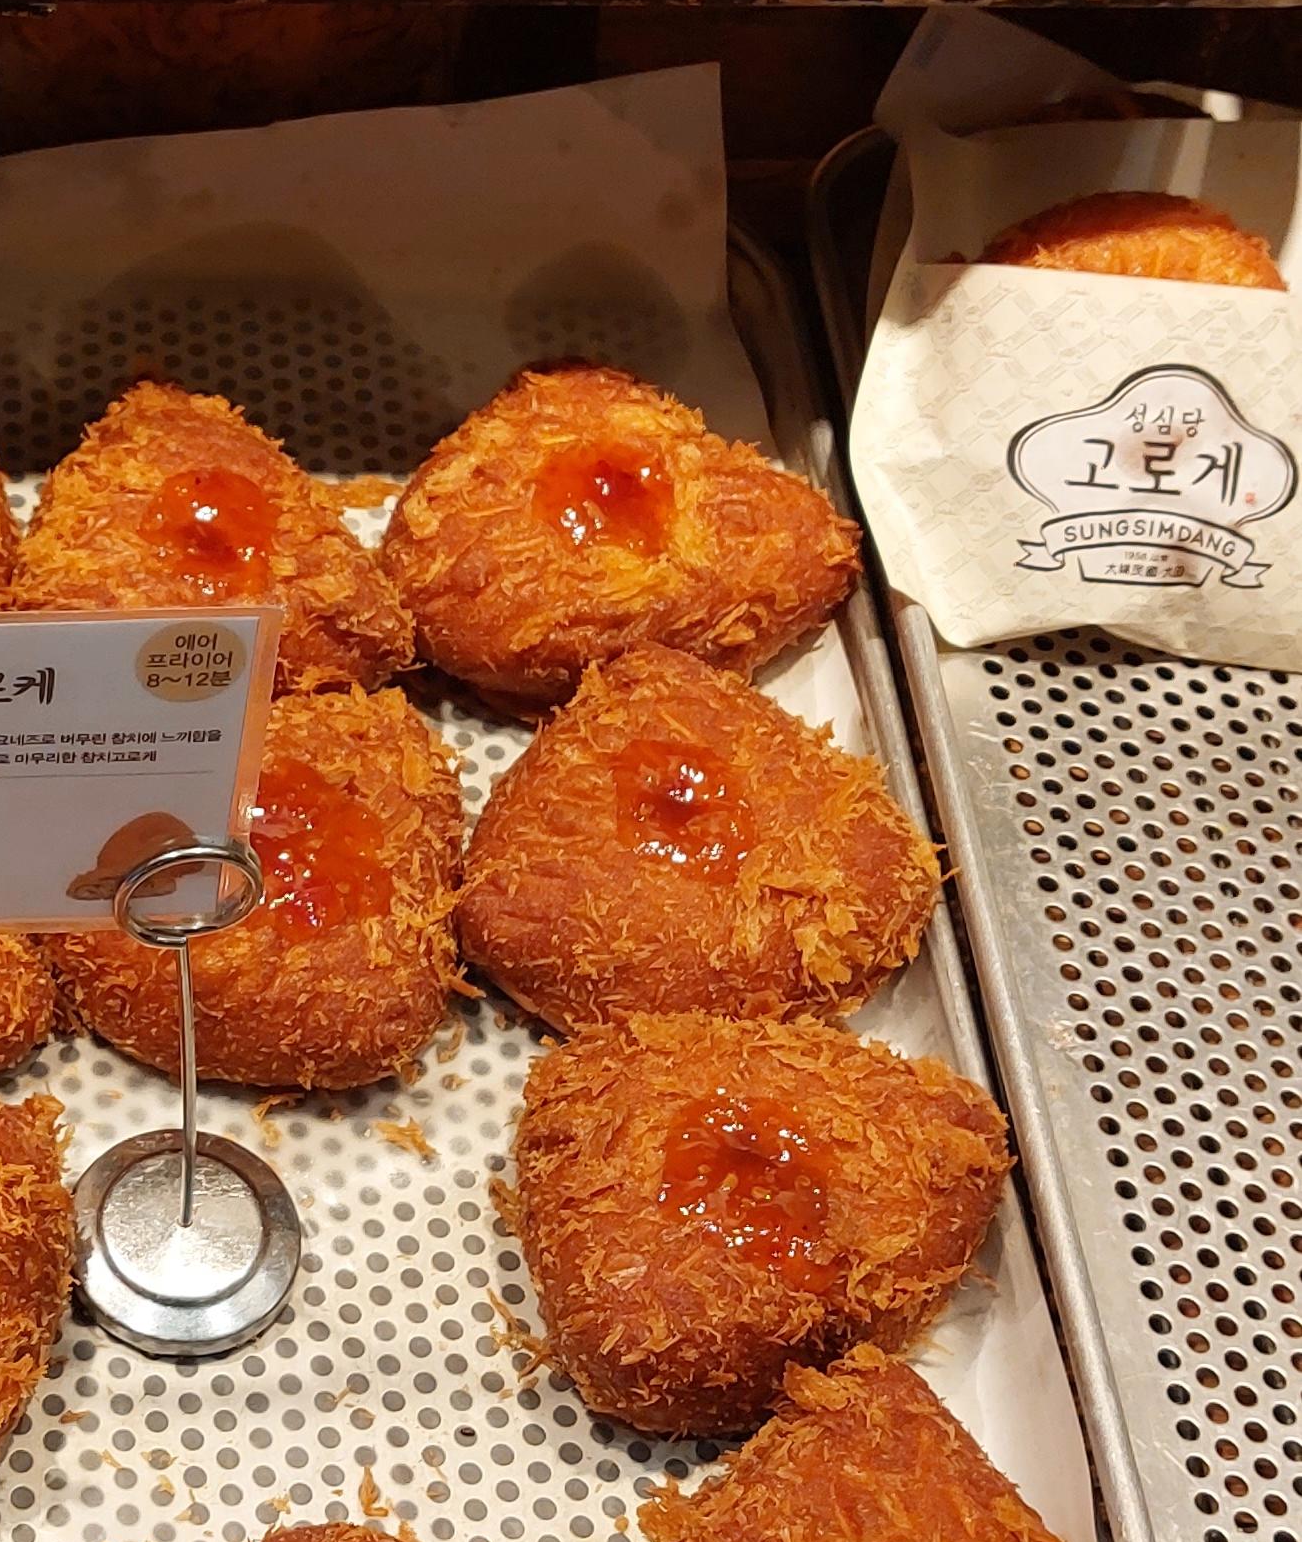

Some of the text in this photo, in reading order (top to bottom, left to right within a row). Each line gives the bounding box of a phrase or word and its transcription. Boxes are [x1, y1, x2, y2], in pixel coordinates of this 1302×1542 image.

[1124, 403, 1206, 438] 성심당
[1064, 519, 1237, 557] SUNGSIMDANG
[175, 633, 218, 651] 에어
[146, 650, 233, 669] 프라이어
[146, 670, 232, 688] 8~12분
[60, 732, 106, 746] 버무린
[111, 731, 157, 745] 참치에
[160, 729, 222, 743] 느끼함을
[14, 751, 77, 766] 마무리한
[80, 749, 157, 764] 참치고로케
